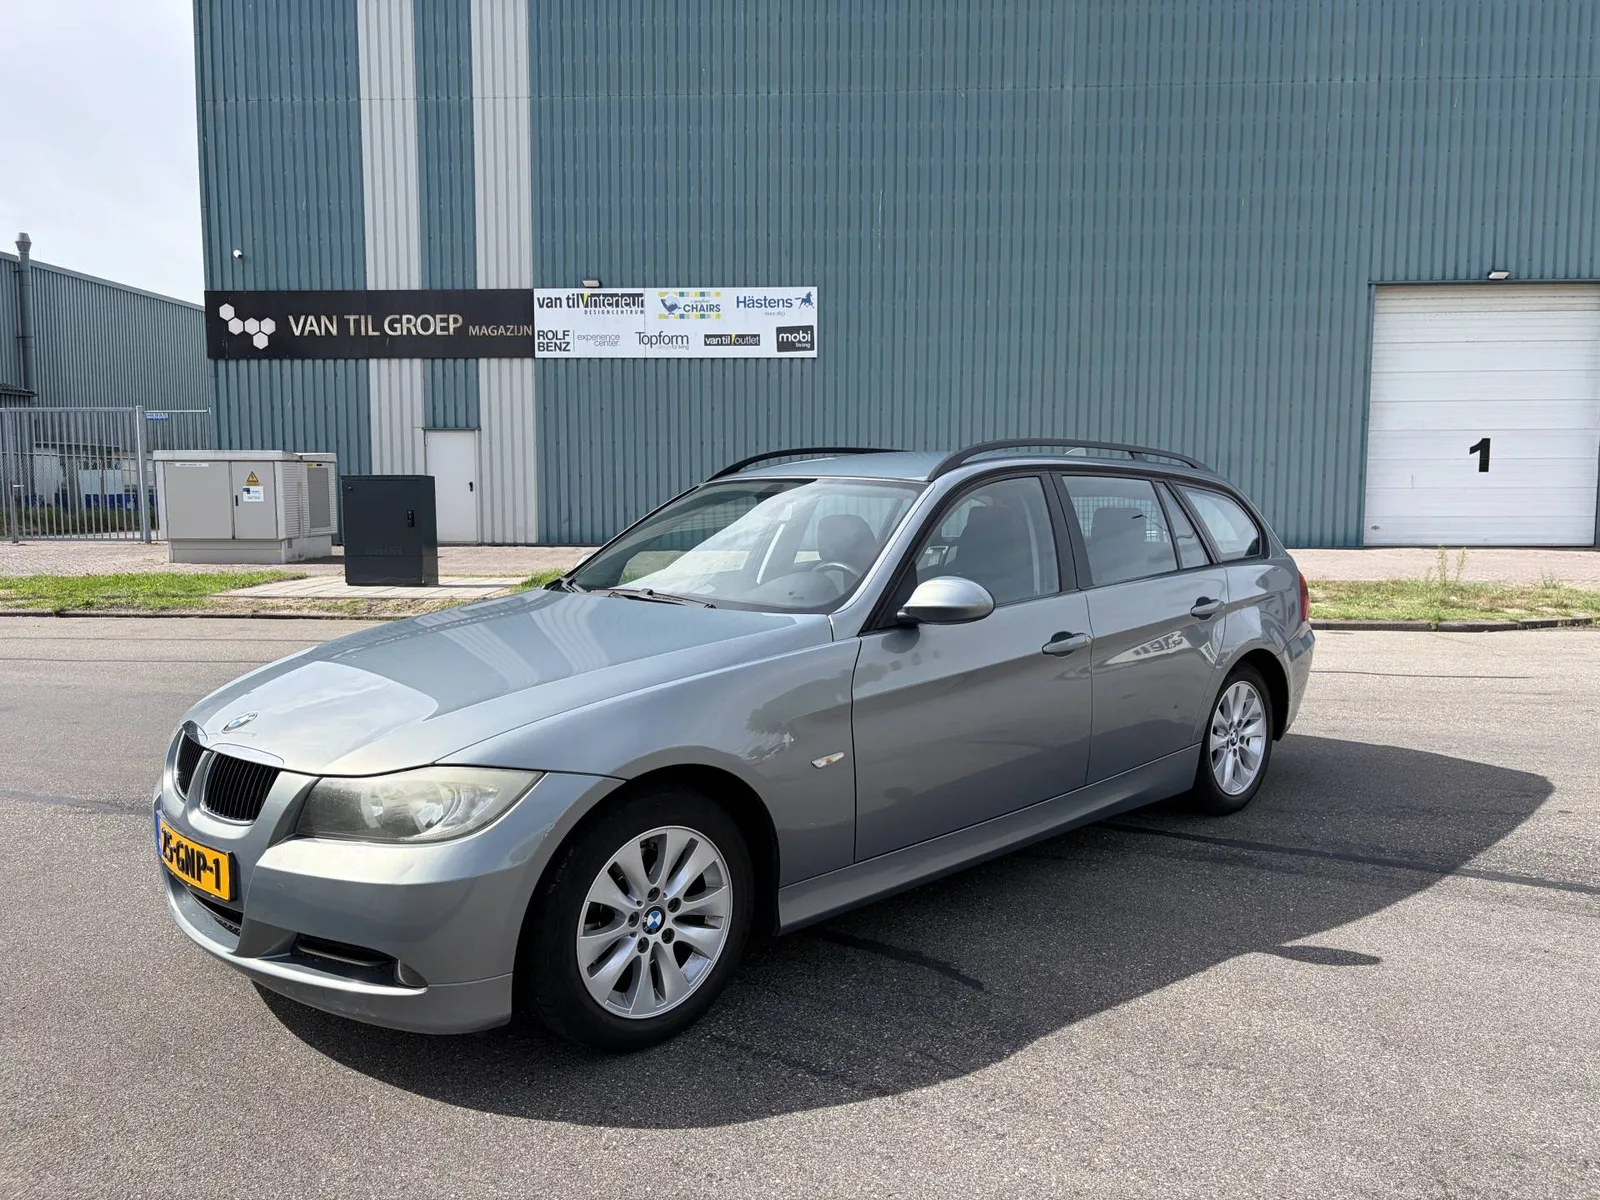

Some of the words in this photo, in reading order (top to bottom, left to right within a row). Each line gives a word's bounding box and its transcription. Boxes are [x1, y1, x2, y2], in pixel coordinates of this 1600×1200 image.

[537, 297, 563, 309] van
[566, 293, 580, 309] til
[736, 295, 793, 309] Hästens
[683, 304, 721, 313] CHAIRS
[288, 314, 338, 337] VAN
[344, 314, 381, 336] TIL
[383, 314, 464, 336] GROEP
[468, 324, 533, 337] MAGAZIJN
[537, 330, 570, 341] ROLF
[577, 333, 621, 342] experience
[635, 330, 690, 349] Topform
[734, 335, 760, 345] outlet
[779, 330, 811, 342] mobi
[537, 341, 571, 352] BENZ
[1469, 437, 1491, 473] 1
